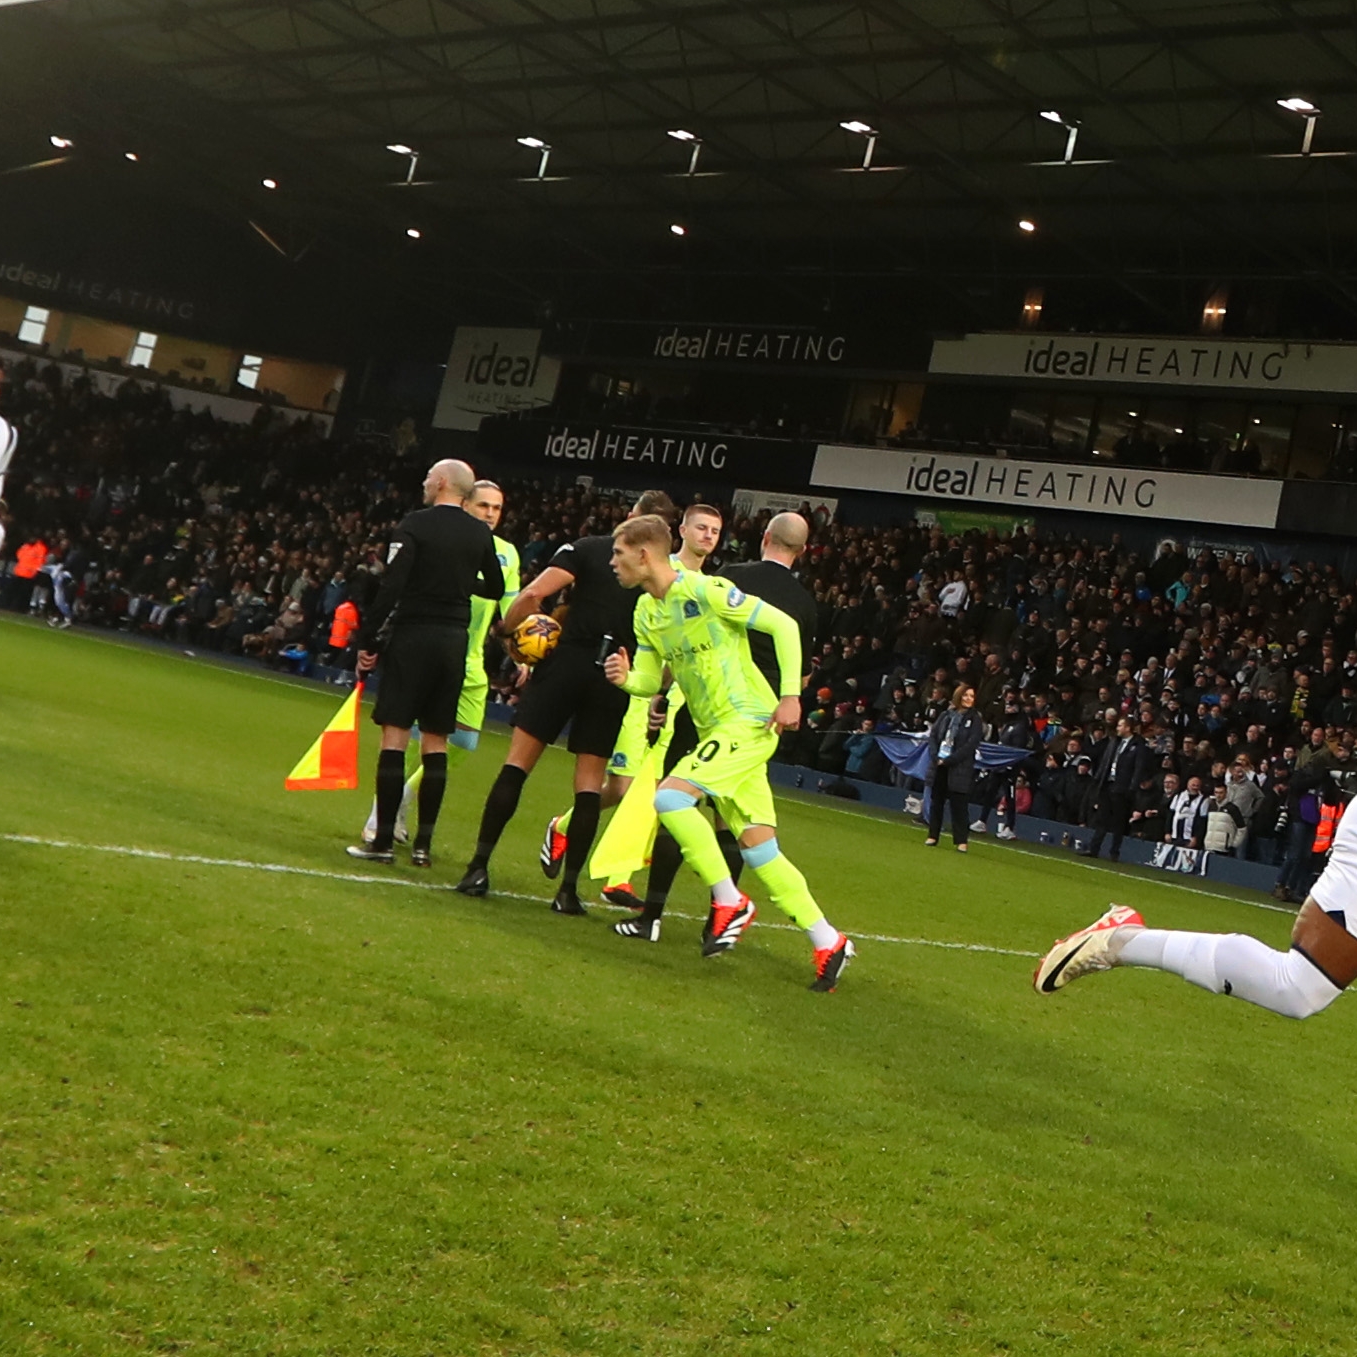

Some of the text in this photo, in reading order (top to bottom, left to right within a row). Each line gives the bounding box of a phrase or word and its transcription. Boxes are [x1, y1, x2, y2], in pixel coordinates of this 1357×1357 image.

[67, 279, 195, 320] HEATING
[464, 342, 542, 388] ideal
[653, 327, 846, 362] ideal HEATING
[1024, 339, 1284, 382] ideal HEATING
[544, 428, 728, 470] ideal HEATING
[906, 456, 1158, 509] ideal HEATING
